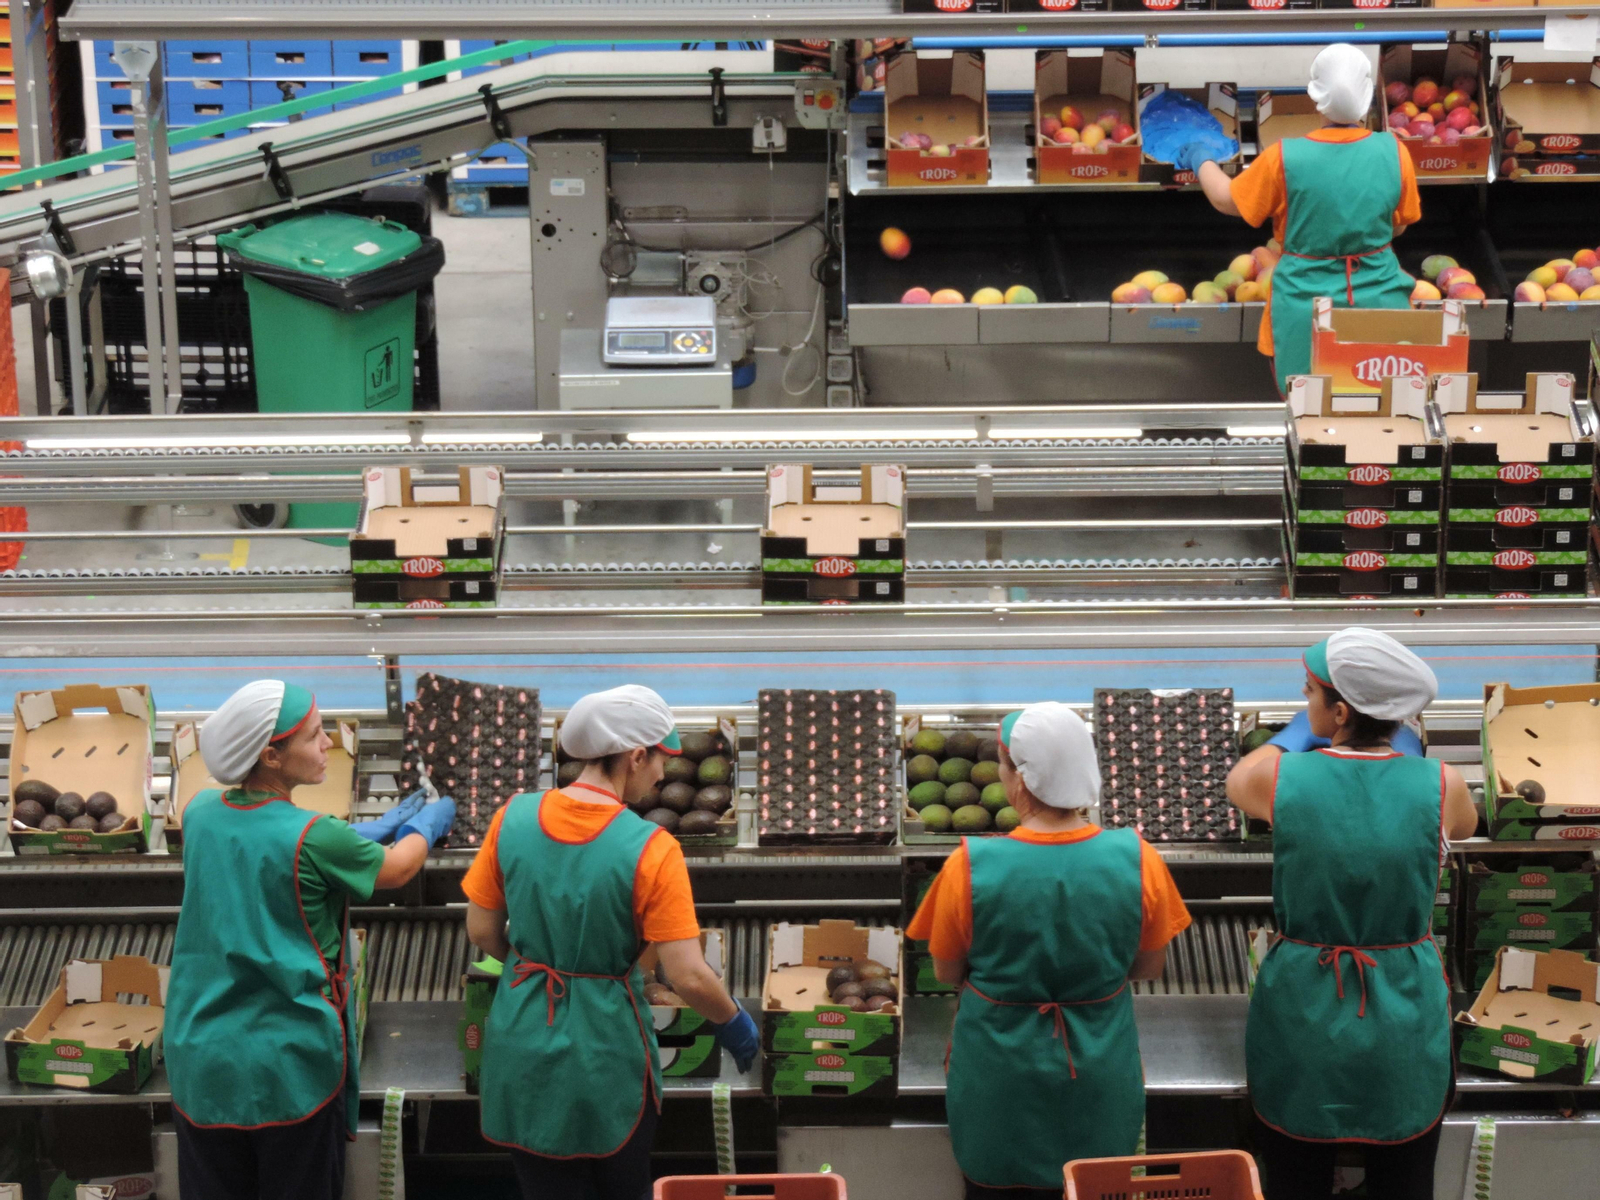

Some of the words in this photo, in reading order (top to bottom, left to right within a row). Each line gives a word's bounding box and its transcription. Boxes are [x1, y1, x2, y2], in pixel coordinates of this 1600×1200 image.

[1542, 135, 1580, 147] TROPS
[1419, 157, 1457, 169] TROPS
[1537, 162, 1575, 174] TROPS
[919, 168, 957, 180] TROPS
[1071, 165, 1108, 178] TROPS
[1174, 171, 1196, 181] TRO
[1356, 355, 1425, 381] TROPS
[1348, 465, 1391, 482] TROPS
[1498, 463, 1540, 480] TROPS
[1345, 509, 1387, 526] TROPS
[1495, 507, 1538, 523] TROPS
[1344, 552, 1385, 568] TROPS
[1493, 550, 1535, 566] TROPS
[402, 557, 444, 574] TROPS
[813, 558, 856, 574] TROPS
[1520, 872, 1548, 884] TROPS
[1519, 913, 1546, 925] TROPS
[817, 1012, 846, 1023] TROPS
[1503, 1033, 1531, 1047] TROPS
[56, 1045, 83, 1057] TROPS
[816, 1055, 845, 1066] TROPS
[116, 1179, 152, 1193] ROPS
